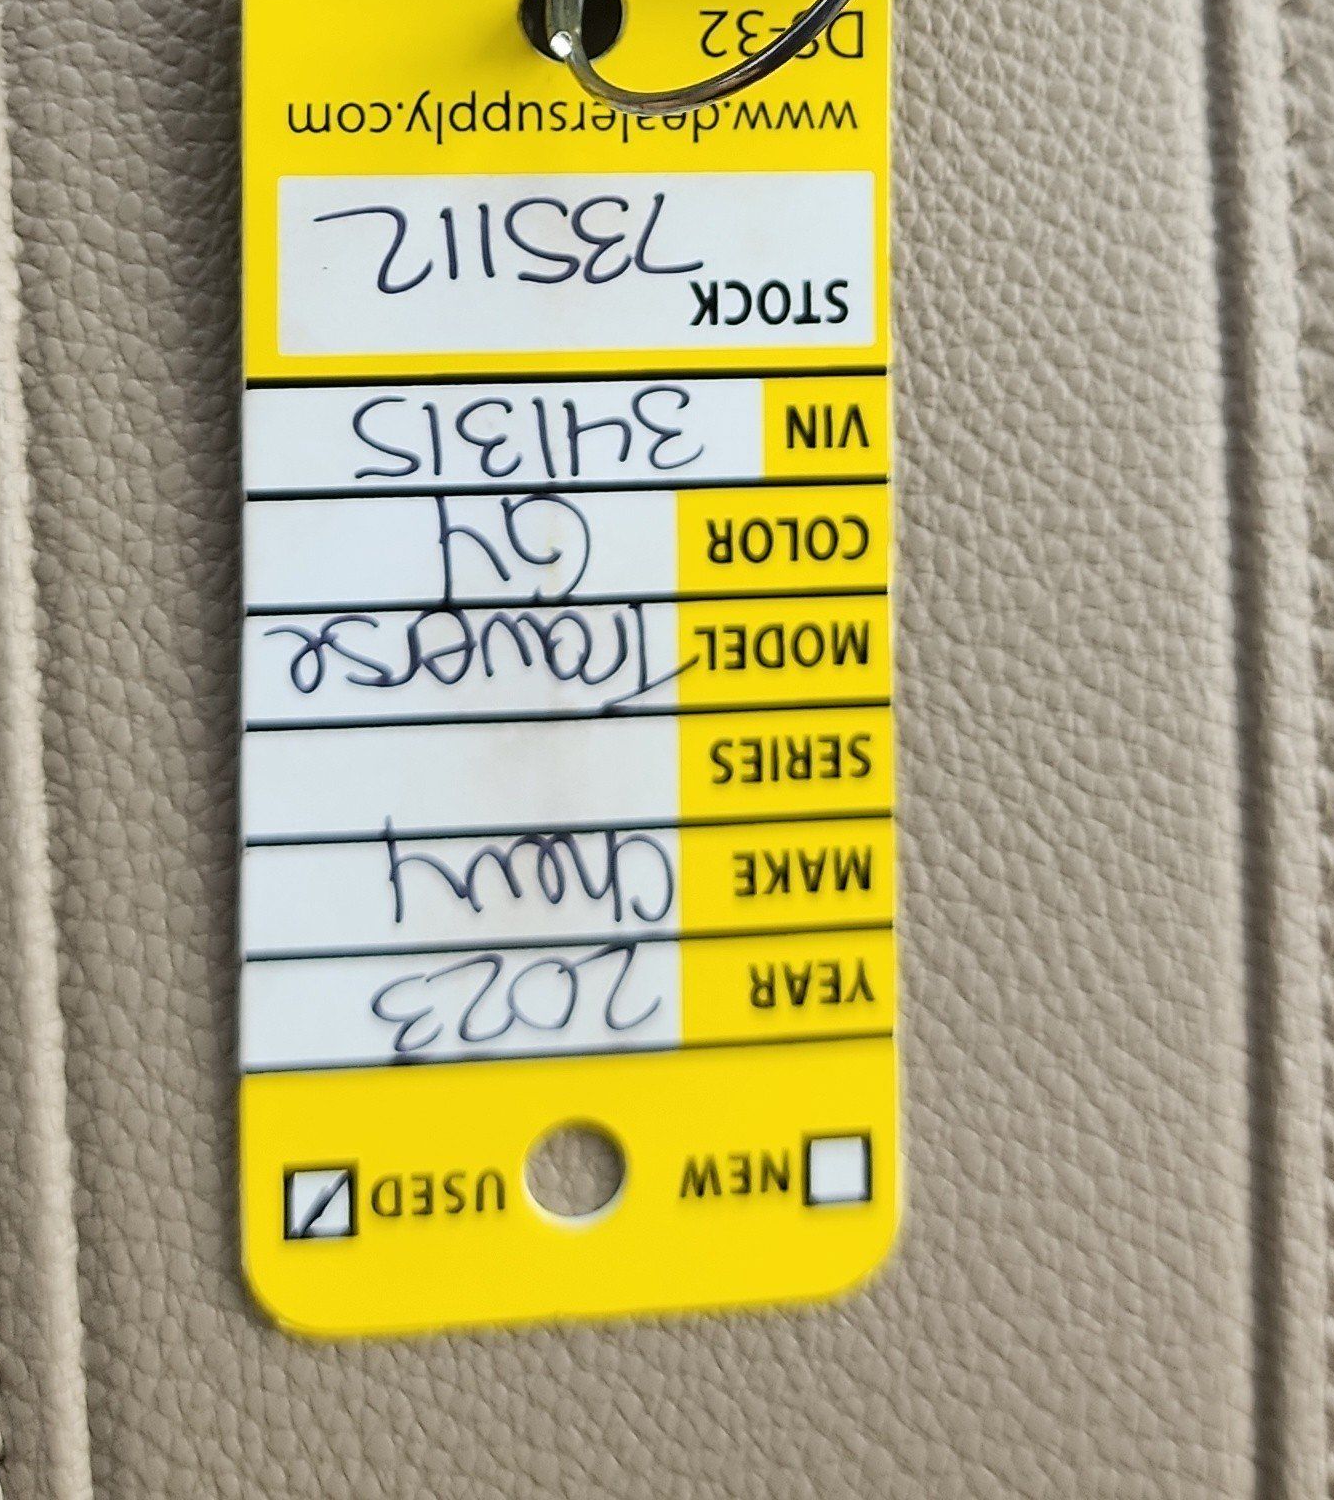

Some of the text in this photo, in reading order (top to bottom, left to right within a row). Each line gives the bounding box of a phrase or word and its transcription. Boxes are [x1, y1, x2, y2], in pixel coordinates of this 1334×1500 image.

[313, 192, 704, 295] 735112
[689, 280, 849, 326] STOCK
[352, 386, 704, 480] 341315
[785, 405, 868, 449] VIN
[706, 516, 869, 563] COLOR
[263, 603, 699, 712] Traverse
[694, 621, 870, 670] MODEL
[710, 735, 871, 785] SERIES
[383, 817, 673, 924] Chevy
[732, 848, 872, 897] MAKE
[370, 943, 660, 1053] 2023
[749, 959, 874, 1009] YEAR
[370, 1172, 506, 1218] USED
[681, 1150, 790, 1199] NEW
